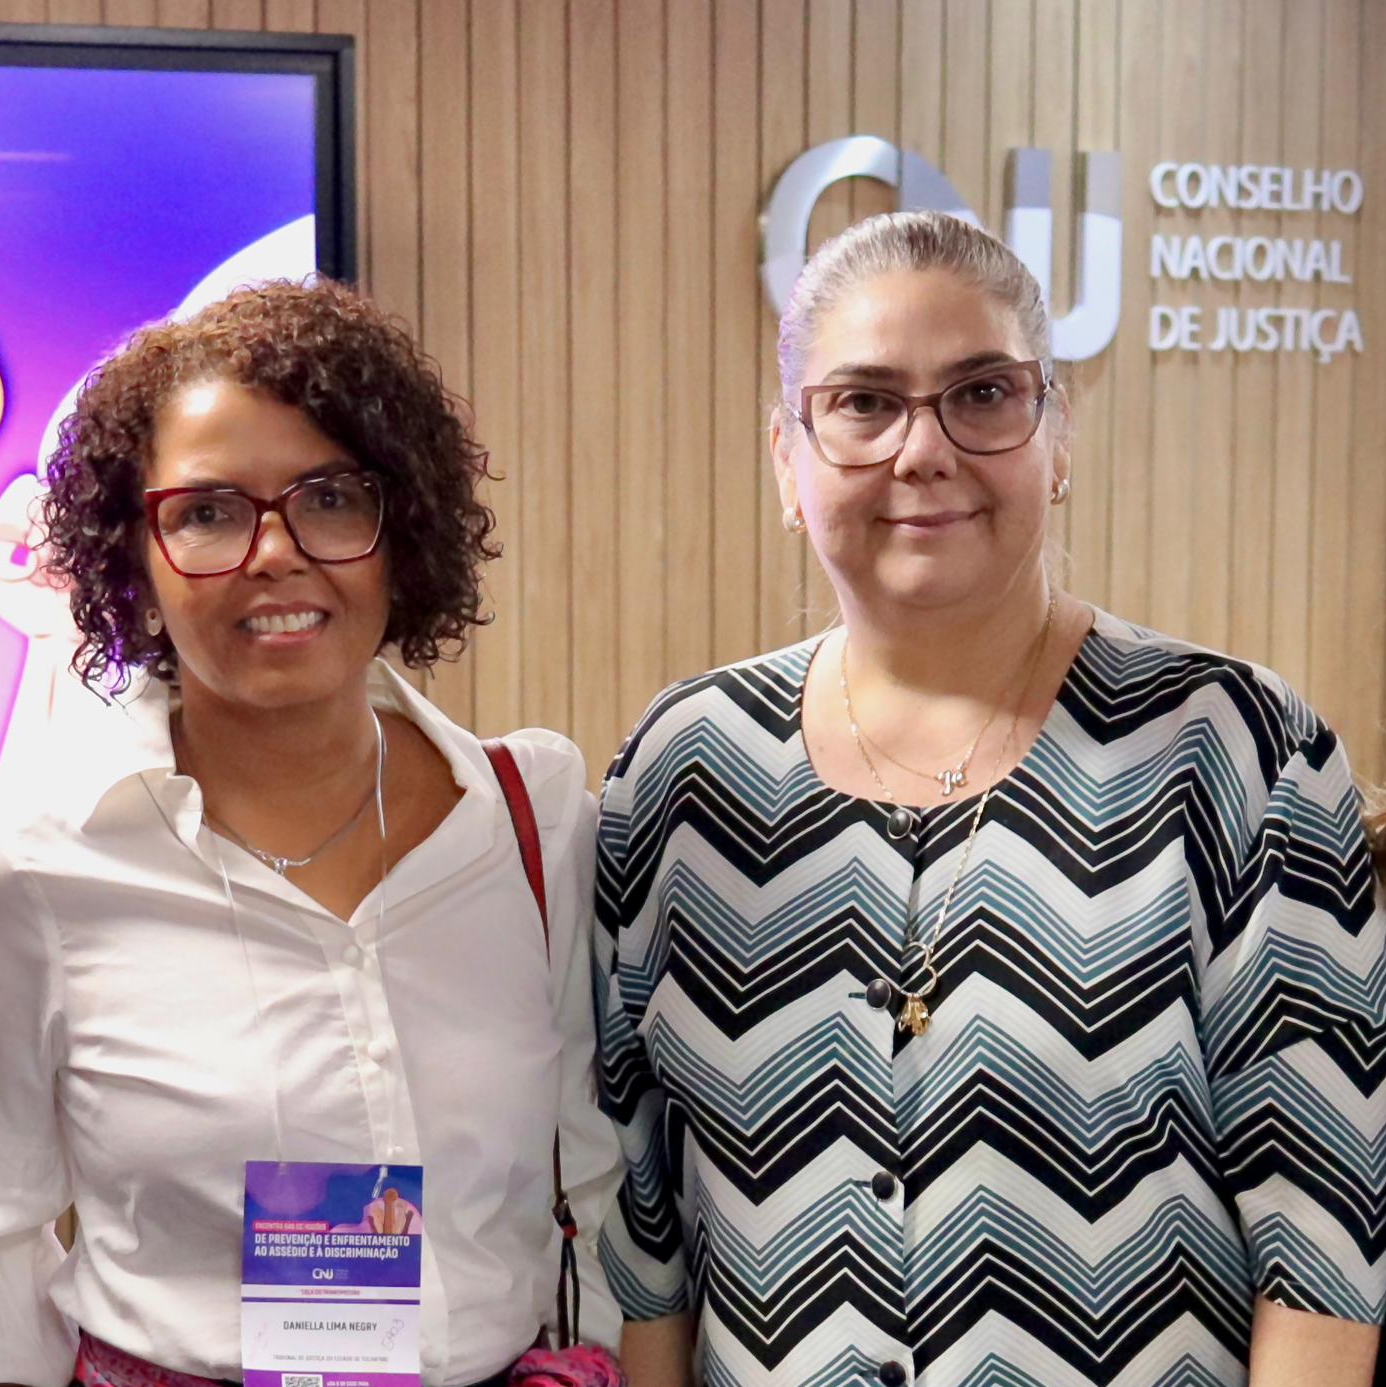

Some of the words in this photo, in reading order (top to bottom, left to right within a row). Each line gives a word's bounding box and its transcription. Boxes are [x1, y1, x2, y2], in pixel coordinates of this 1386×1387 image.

[1149, 162, 1363, 214] CONSELHO
[1150, 235, 1352, 284] NACIONAL
[1150, 308, 1200, 351] DE
[1211, 307, 1364, 363] JUSTIÇA
[255, 1234, 267, 1244] DE
[269, 1232, 323, 1248] PREVENÇÃO
[325, 1235, 330, 1245] E
[331, 1235, 409, 1246] ENFRENTAMENTO
[255, 1246, 267, 1256] AO
[269, 1244, 307, 1257] ASSÉDIO
[309, 1247, 315, 1257] E
[325, 1246, 398, 1260] DISCRIMINAÇÃO
[283, 1321, 324, 1330] DANIELLA
[326, 1321, 347, 1331] LIMA
[349, 1322, 377, 1332] NEGRY
